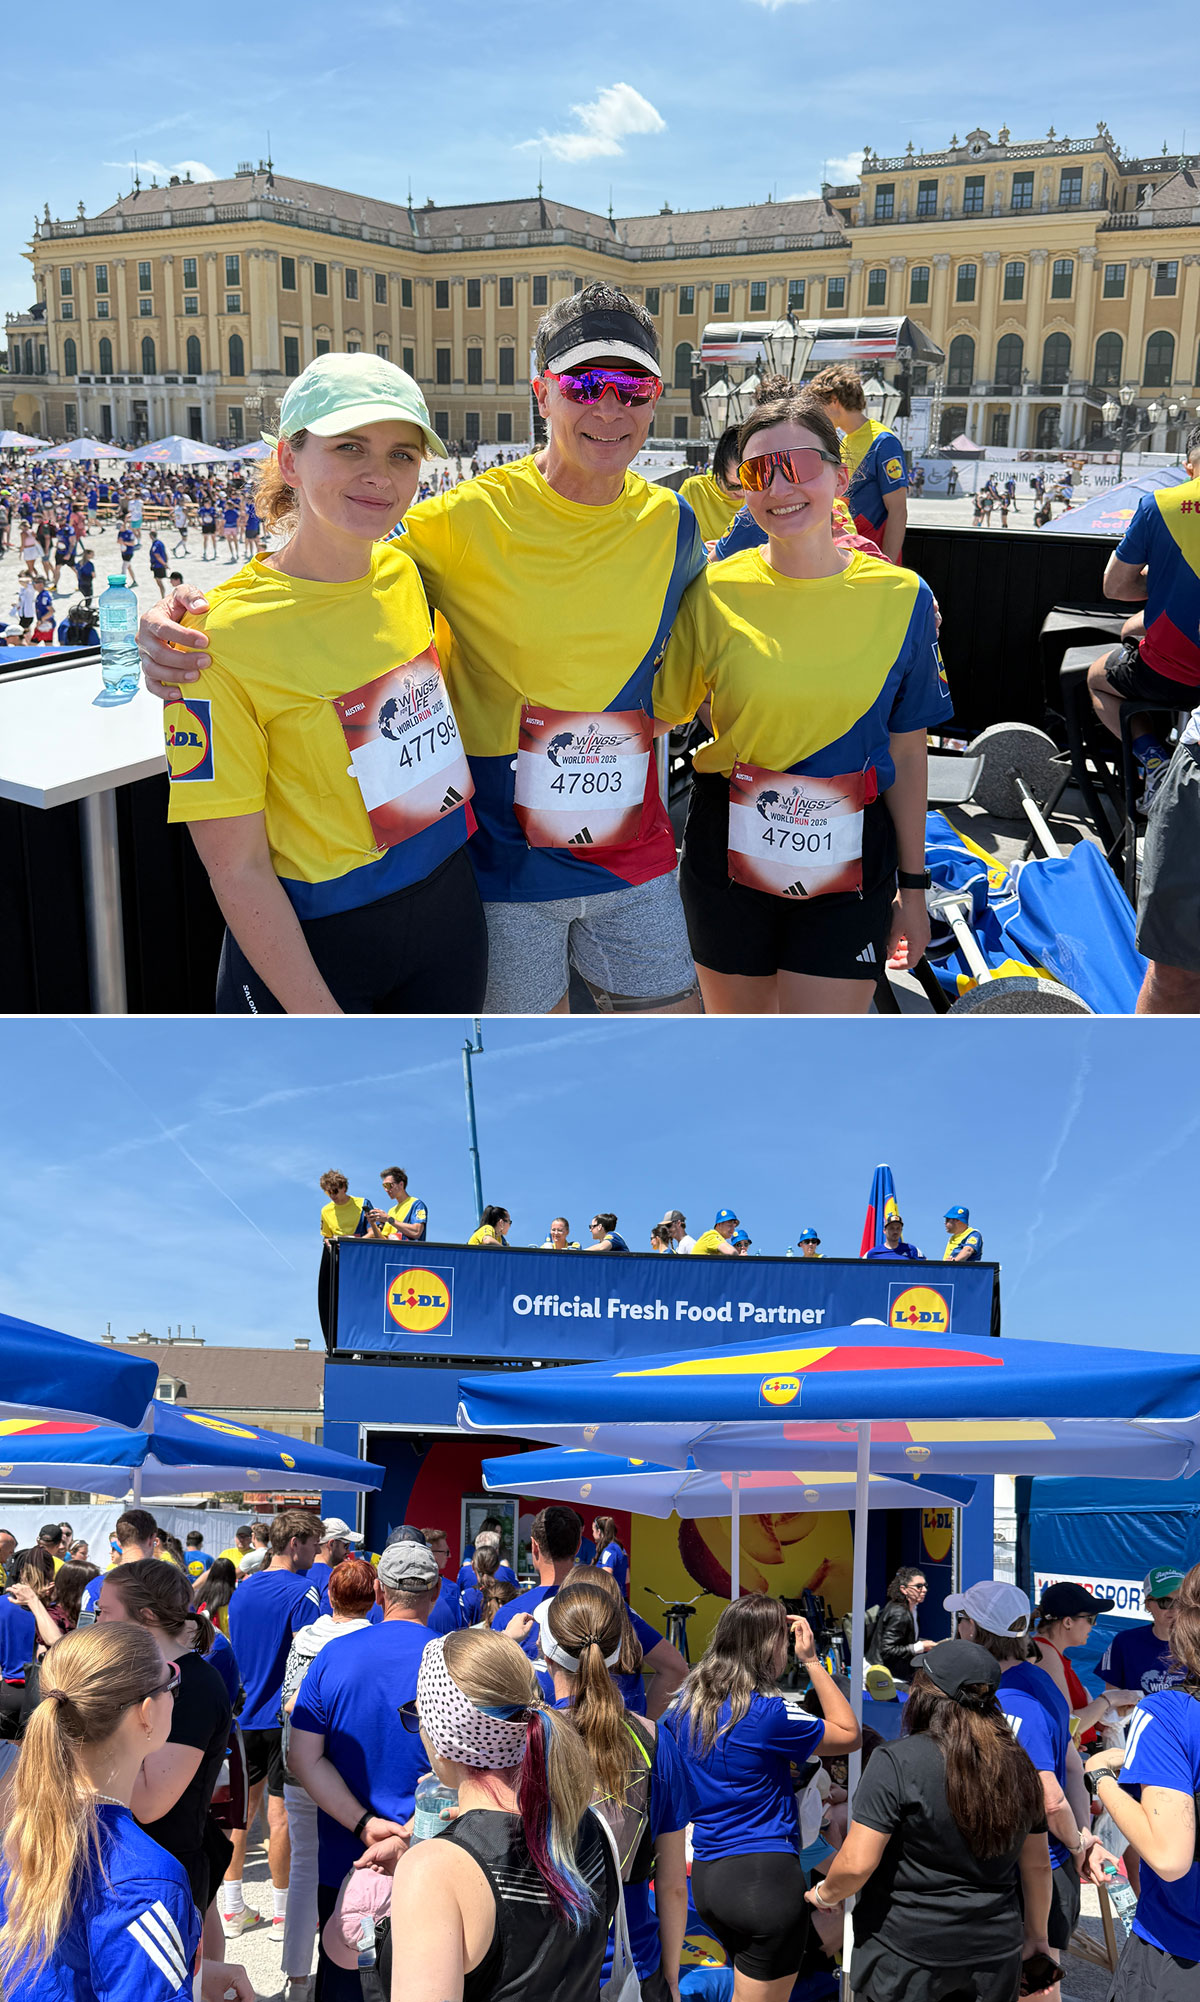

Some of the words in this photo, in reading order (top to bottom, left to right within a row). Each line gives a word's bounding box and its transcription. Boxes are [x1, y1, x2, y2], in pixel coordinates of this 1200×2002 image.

[345, 703, 366, 717] AUSTRIA
[399, 714, 457, 768] 47799
[600, 755, 617, 764] 2026
[550, 771, 622, 794] 47803
[810, 818, 828, 827] 2026
[761, 826, 832, 853] 47901
[512, 1294, 601, 1319] Official
[607, 1297, 669, 1321] Fresh
[675, 1300, 733, 1323] Food
[738, 1302, 825, 1324] Partner
